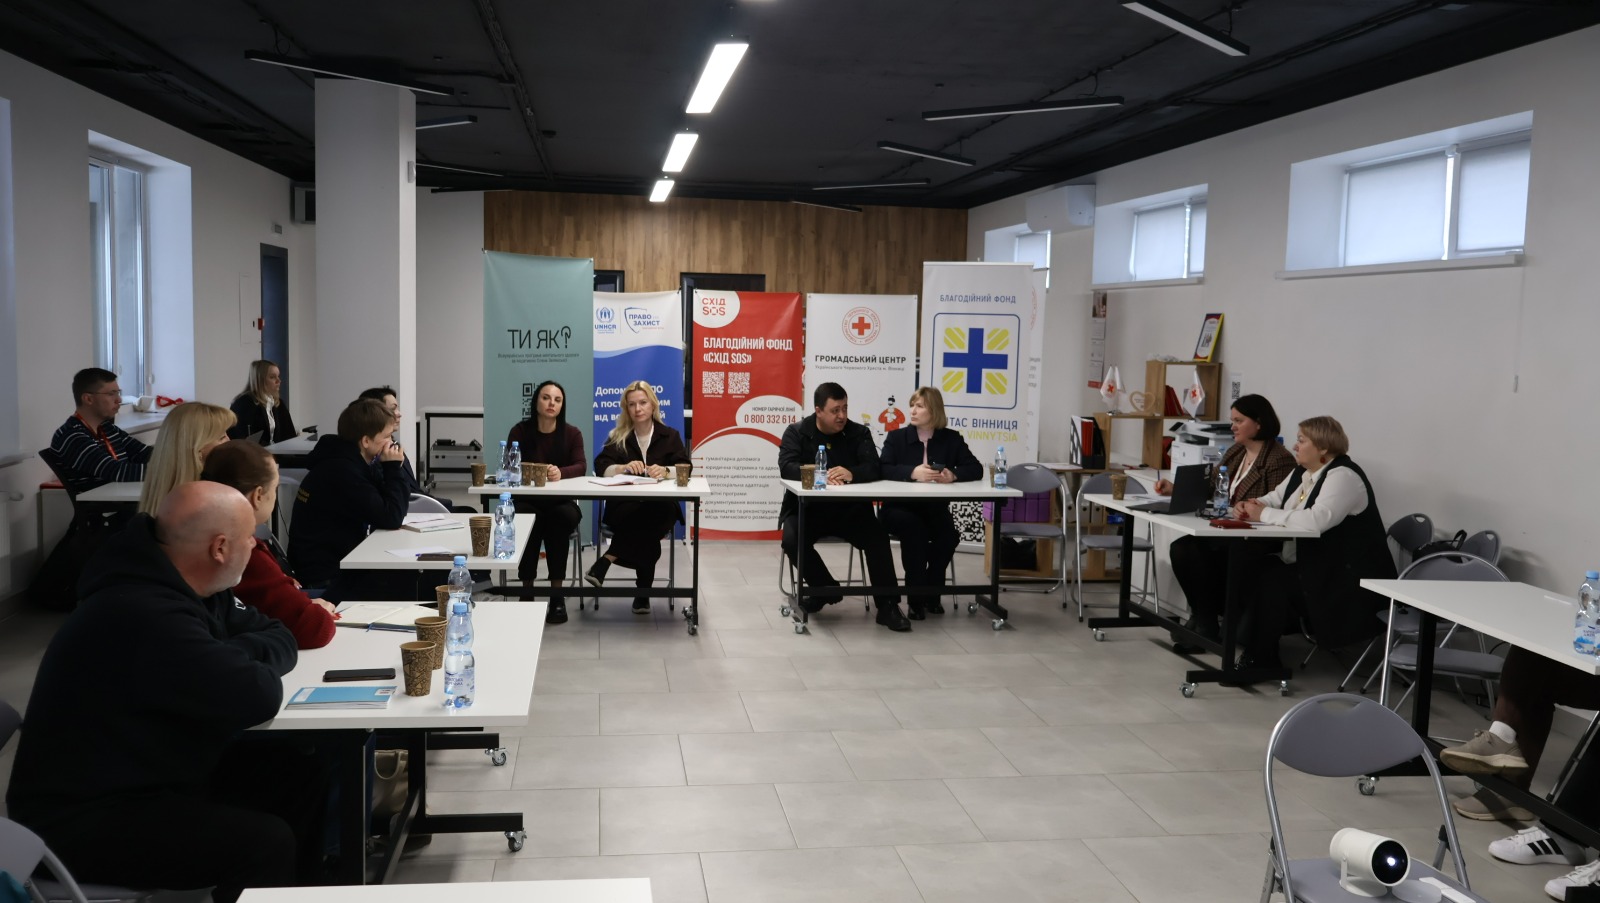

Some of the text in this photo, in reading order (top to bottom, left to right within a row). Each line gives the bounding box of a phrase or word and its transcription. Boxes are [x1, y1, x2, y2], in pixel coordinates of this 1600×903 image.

[940, 294, 1016, 304] БЛАГОДІЙНИЙ ФОНД
[702, 306, 726, 316] SOS
[507, 329, 531, 349] ТИ
[703, 337, 793, 351] БЛАГОДІЙНИЙ ФОНД
[703, 352, 752, 364] «СХІД SOS»
[815, 354, 907, 364] ГРОМАДСЬКИЙ ЦЕНТР
[744, 414, 797, 424] 0 800 332 614
[972, 419, 1018, 431] ВІННИЦЯ
[967, 431, 1018, 442] VINNYTSIA
